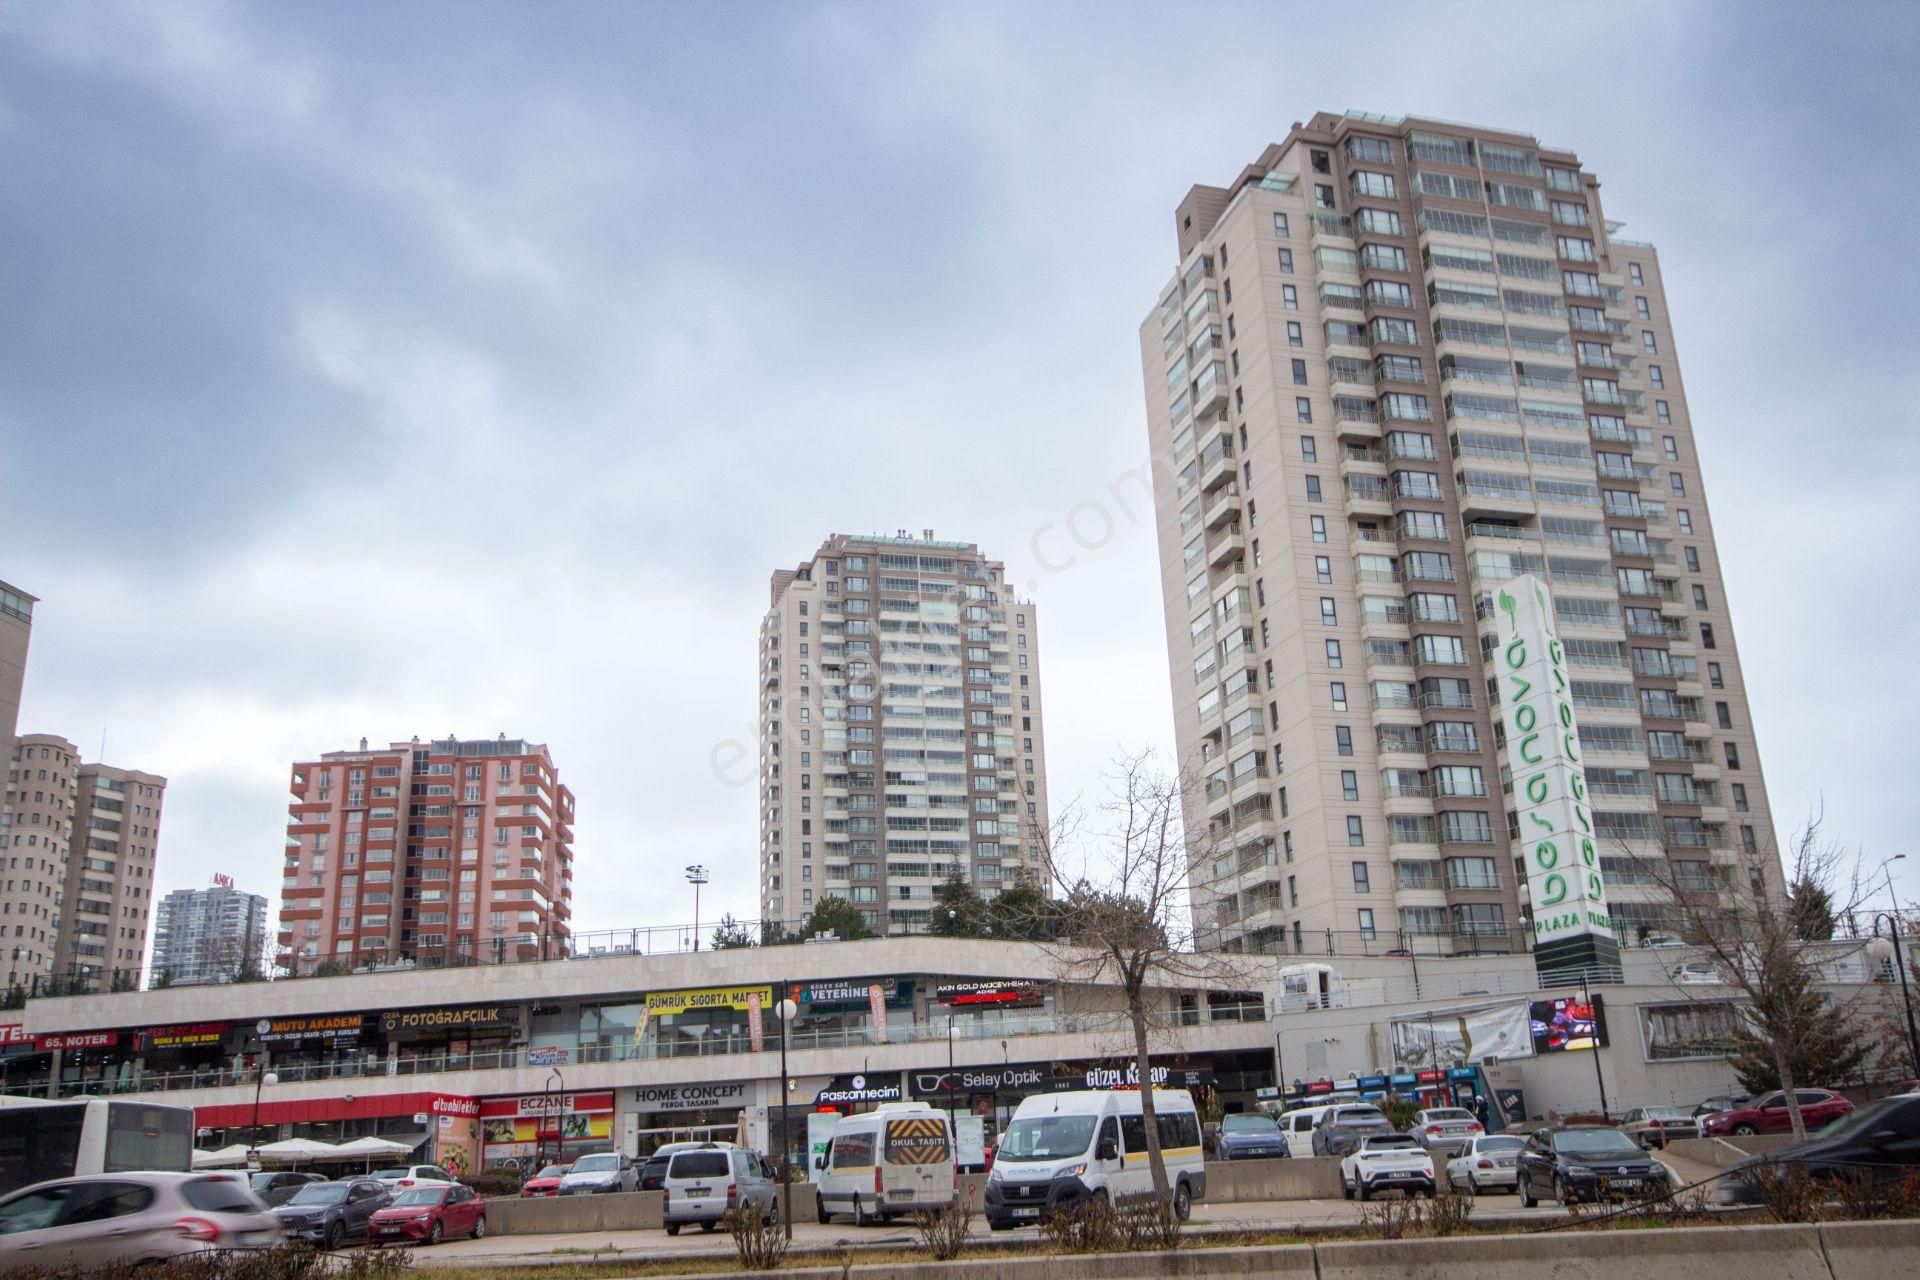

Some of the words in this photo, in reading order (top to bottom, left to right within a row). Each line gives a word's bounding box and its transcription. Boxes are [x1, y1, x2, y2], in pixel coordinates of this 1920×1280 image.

[1535, 912, 1580, 933] PLAZA
[811, 986, 869, 1000] VETERİNE
[937, 984, 955, 992] AKIN
[649, 995, 687, 1009] GÜMRÜK
[309, 1014, 362, 1029] AKADEMİ
[402, 1008, 500, 1027] FOTOĞRAFÇILIK
[66, 1034, 108, 1046] NOTER
[963, 1071, 1000, 1088] Selay
[1003, 1068, 1041, 1087] Optik
[635, 1089, 678, 1103] HOME
[681, 1084, 745, 1100] CONCEPT
[520, 1096, 572, 1110] ECZANE
[661, 1101, 684, 1109] PERDE
[687, 1099, 719, 1107] TASARIM
[890, 1138, 916, 1147] OKUL
